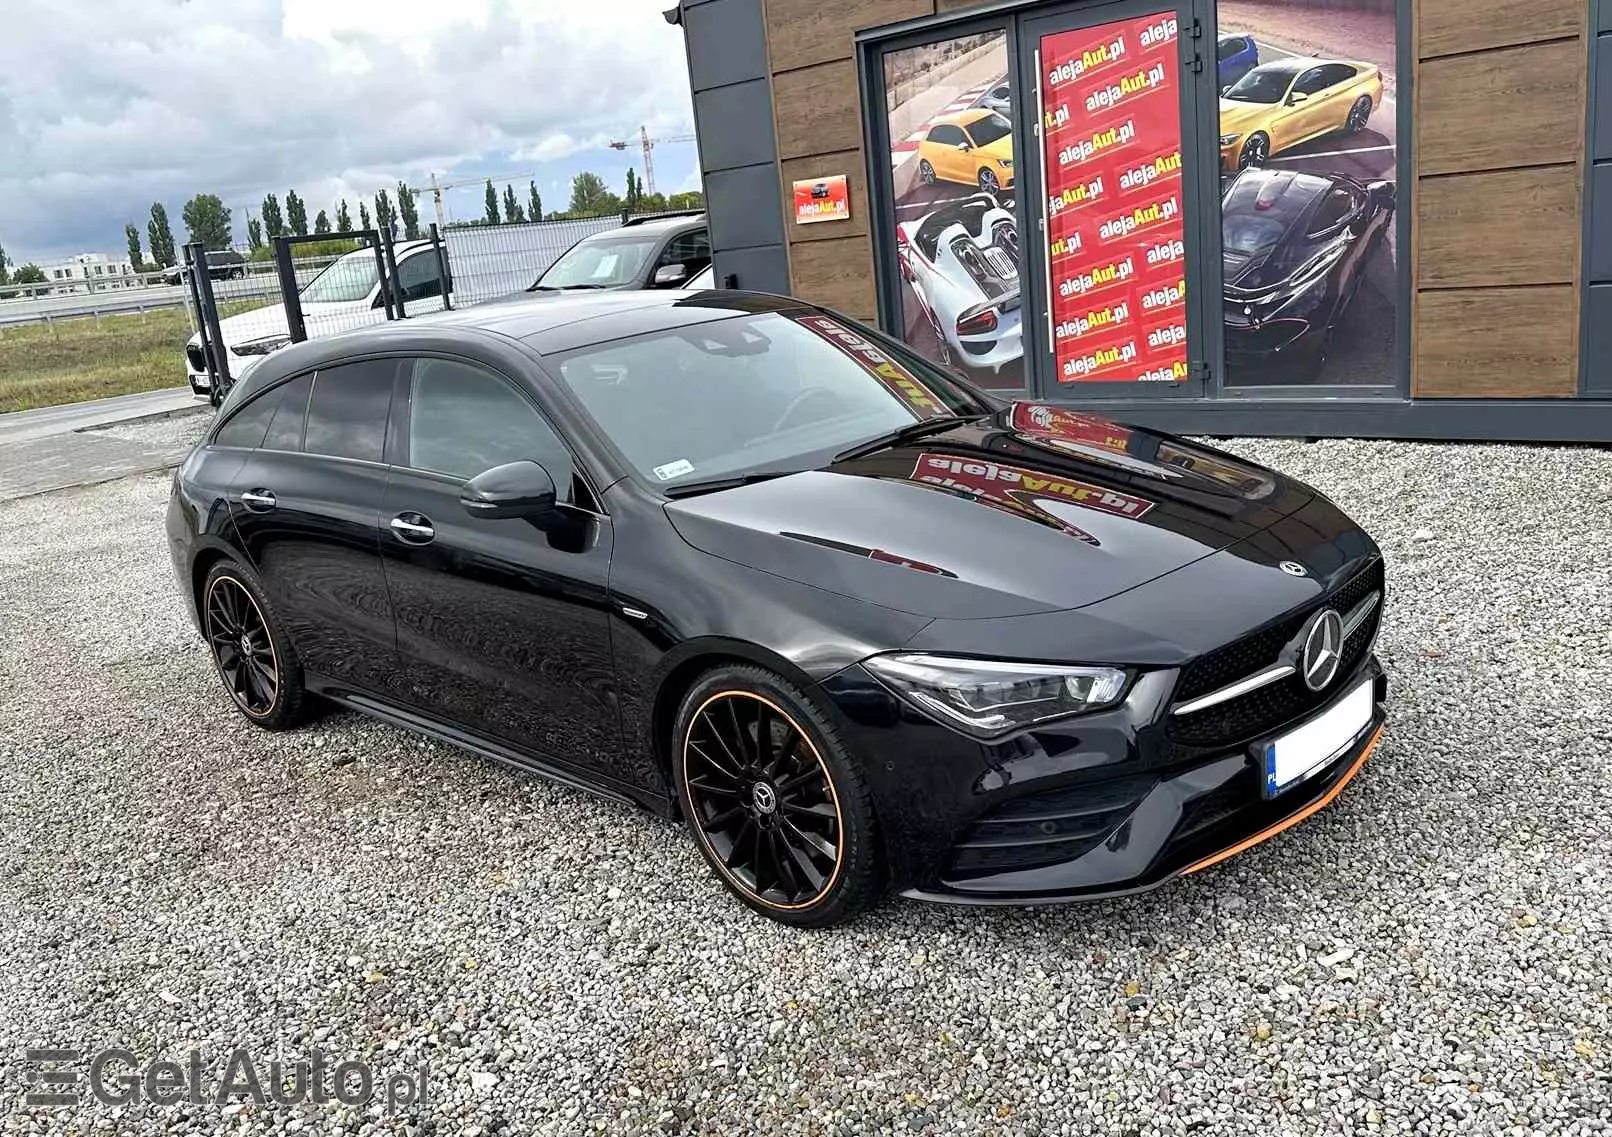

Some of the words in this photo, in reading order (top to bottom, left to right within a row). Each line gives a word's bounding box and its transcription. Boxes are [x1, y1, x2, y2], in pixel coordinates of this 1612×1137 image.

[1140, 19, 1177, 47] aleja
[1049, 37, 1125, 85] alejaAut.pl
[1086, 63, 1164, 111] alejaAut.pl
[1059, 120, 1135, 165] alejaAut.pl
[1049, 176, 1103, 216] jaAut.pl
[1100, 197, 1178, 239] alejaAut.pl
[1146, 240, 1184, 264] aleja
[1059, 258, 1133, 297] alejaAut.pl
[1056, 303, 1129, 338] alejaAut.pl
[1063, 341, 1137, 376] alejaAut.pl
